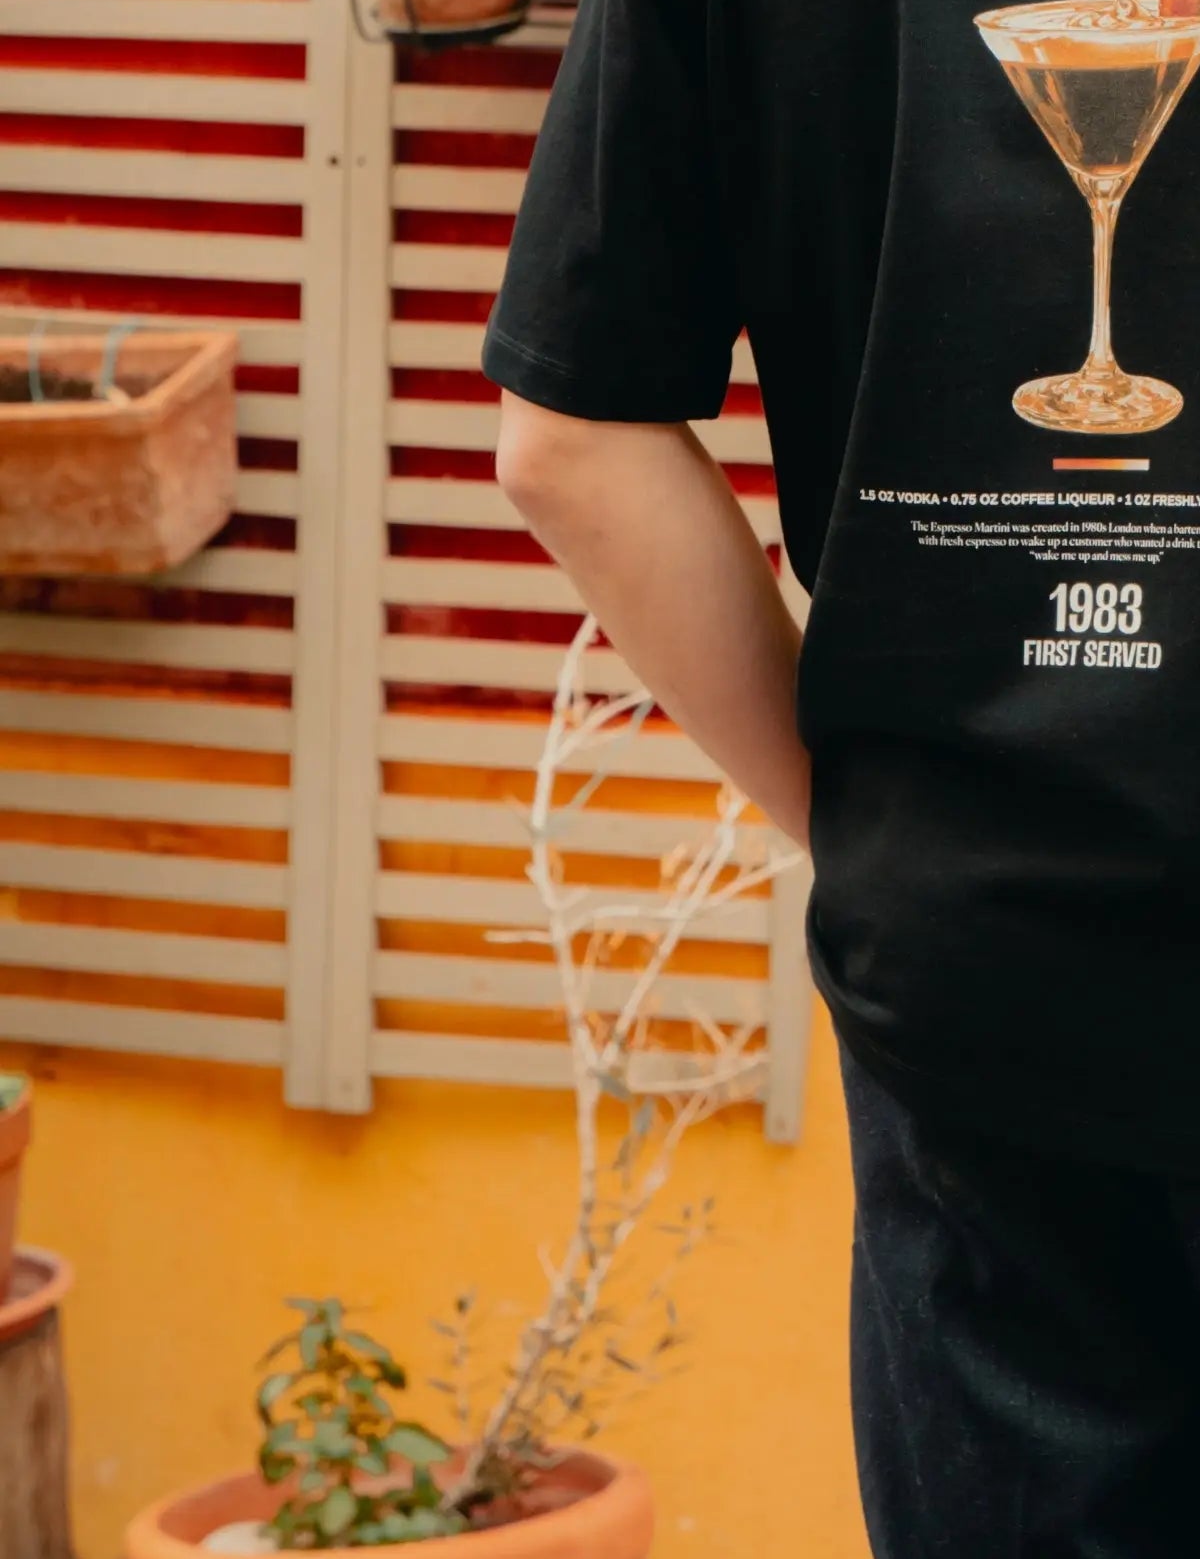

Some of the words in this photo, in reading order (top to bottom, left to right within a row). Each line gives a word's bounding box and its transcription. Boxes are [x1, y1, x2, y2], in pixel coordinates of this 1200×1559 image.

[859, 488, 876, 501] 1.5
[877, 490, 895, 502] OZ
[896, 491, 940, 505] VODKA
[950, 493, 977, 506] 0.75
[979, 493, 999, 506] OZ
[1001, 492, 1056, 506] COFFEE
[1057, 492, 1116, 507] LIQUEUR
[1124, 493, 1133, 506] 1
[1134, 493, 1152, 506] OZ
[910, 520, 930, 532] The
[930, 521, 973, 535] Espresso
[974, 521, 1011, 534] Martini
[1012, 525, 1031, 533] was
[1031, 521, 1069, 533] created
[1070, 522, 1080, 533] in
[1081, 521, 1108, 533] 1980s
[1108, 522, 1142, 534] London
[1143, 522, 1167, 534] when
[918, 535, 938, 546] with
[939, 535, 964, 547] fresh
[965, 538, 1007, 550] espresso
[1008, 538, 1019, 547] to
[1020, 535, 1046, 547] wake
[1047, 539, 1061, 550] up
[1068, 538, 1113, 548] customer
[1113, 536, 1133, 547] who
[1133, 537, 1165, 548] wanted
[1171, 537, 1196, 549] drink
[1061, 552, 1077, 561] me
[1078, 552, 1091, 564] up
[1091, 550, 1109, 561] and
[1109, 553, 1132, 562] mess
[1132, 553, 1147, 562] me
[1049, 581, 1143, 635] 1983
[1023, 639, 1081, 666] FIRST
[1082, 640, 1163, 669] SERVED
